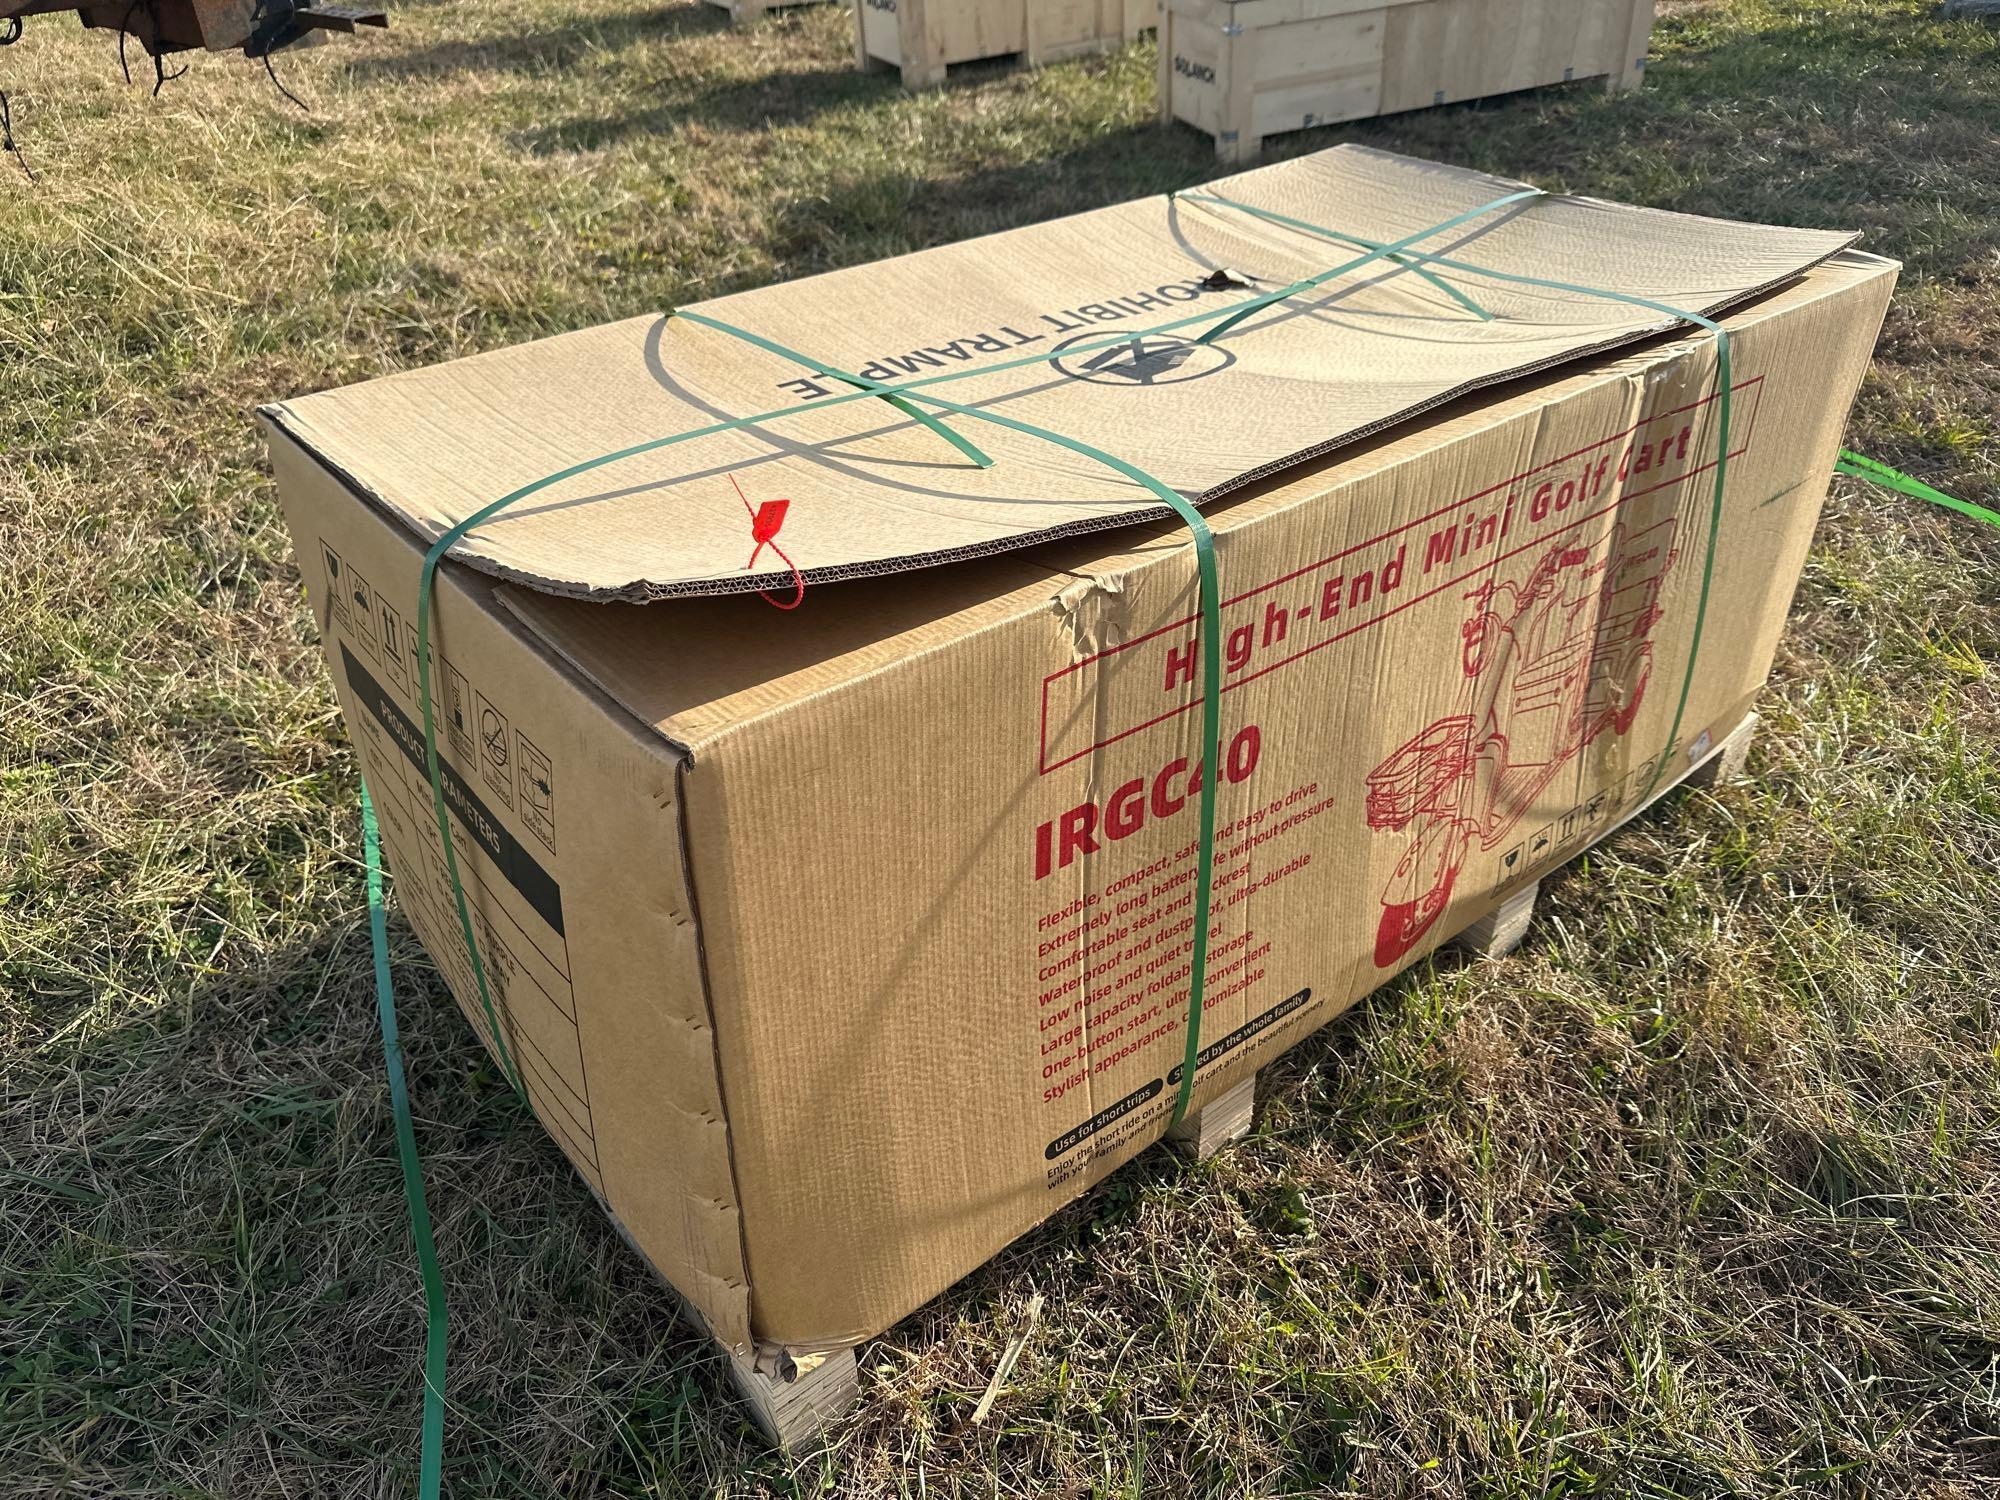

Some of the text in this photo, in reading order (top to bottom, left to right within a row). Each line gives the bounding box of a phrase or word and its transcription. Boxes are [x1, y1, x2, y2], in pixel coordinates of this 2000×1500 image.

[1164, 426, 1692, 692] Hgh-End Mini Golf Cart
[380, 700, 425, 764] PRODUCT
[1035, 724, 1261, 881] IRGC40
[1038, 893, 1101, 932] Flexible,
[1105, 857, 1171, 898] compact,
[1214, 822, 1233, 842] nd
[1236, 806, 1266, 832] easy
[1269, 799, 1282, 815] to
[1285, 782, 1318, 807] drive
[1038, 910, 1112, 958] Extremely
[1116, 892, 1148, 918] long
[1152, 867, 1199, 898] battery
[1229, 824, 1279, 859] without
[1280, 797, 1334, 835] pressure
[1038, 926, 1129, 983] Comfortable
[1132, 909, 1162, 933] seat
[1165, 891, 1191, 916] and
[1039, 952, 1122, 1007] Waterproof
[1124, 936, 1151, 962] and
[1228, 853, 1312, 907] ultra-durable
[1040, 921, 1222, 1032] Low noise and quiet trel
[1041, 1025, 1082, 1056] Large
[1085, 990, 1144, 1031] capacity
[1206, 930, 1254, 964] storage
[1044, 968, 1265, 1104] Stylish appearance, ctomizable
[1211, 1043, 1225, 1058] by
[1225, 1032, 1242, 1048] the
[1243, 1014, 1273, 1037] whole
[1274, 994, 1304, 1018] family
[1042, 1025, 1124, 1079] One-button
[1127, 1004, 1162, 1031] start,
[1047, 1155, 1075, 1180] Enjoy
[1076, 1144, 1093, 1160] the
[1094, 1128, 1120, 1149] short
[1121, 1115, 1141, 1133] ride
[1142, 1107, 1155, 1120] on
[1205, 1064, 1223, 1080] cart
[1224, 1050, 1241, 1068] and
[1242, 1042, 1257, 1059] the
[1257, 1018, 1295, 1047] beautiful
[1047, 1172, 1070, 1190] with
[1071, 1155, 1093, 1177] your
[1094, 1136, 1127, 1159] family
[1128, 1125, 1147, 1141] and
[1054, 1088, 1152, 1152] Use for short trips
